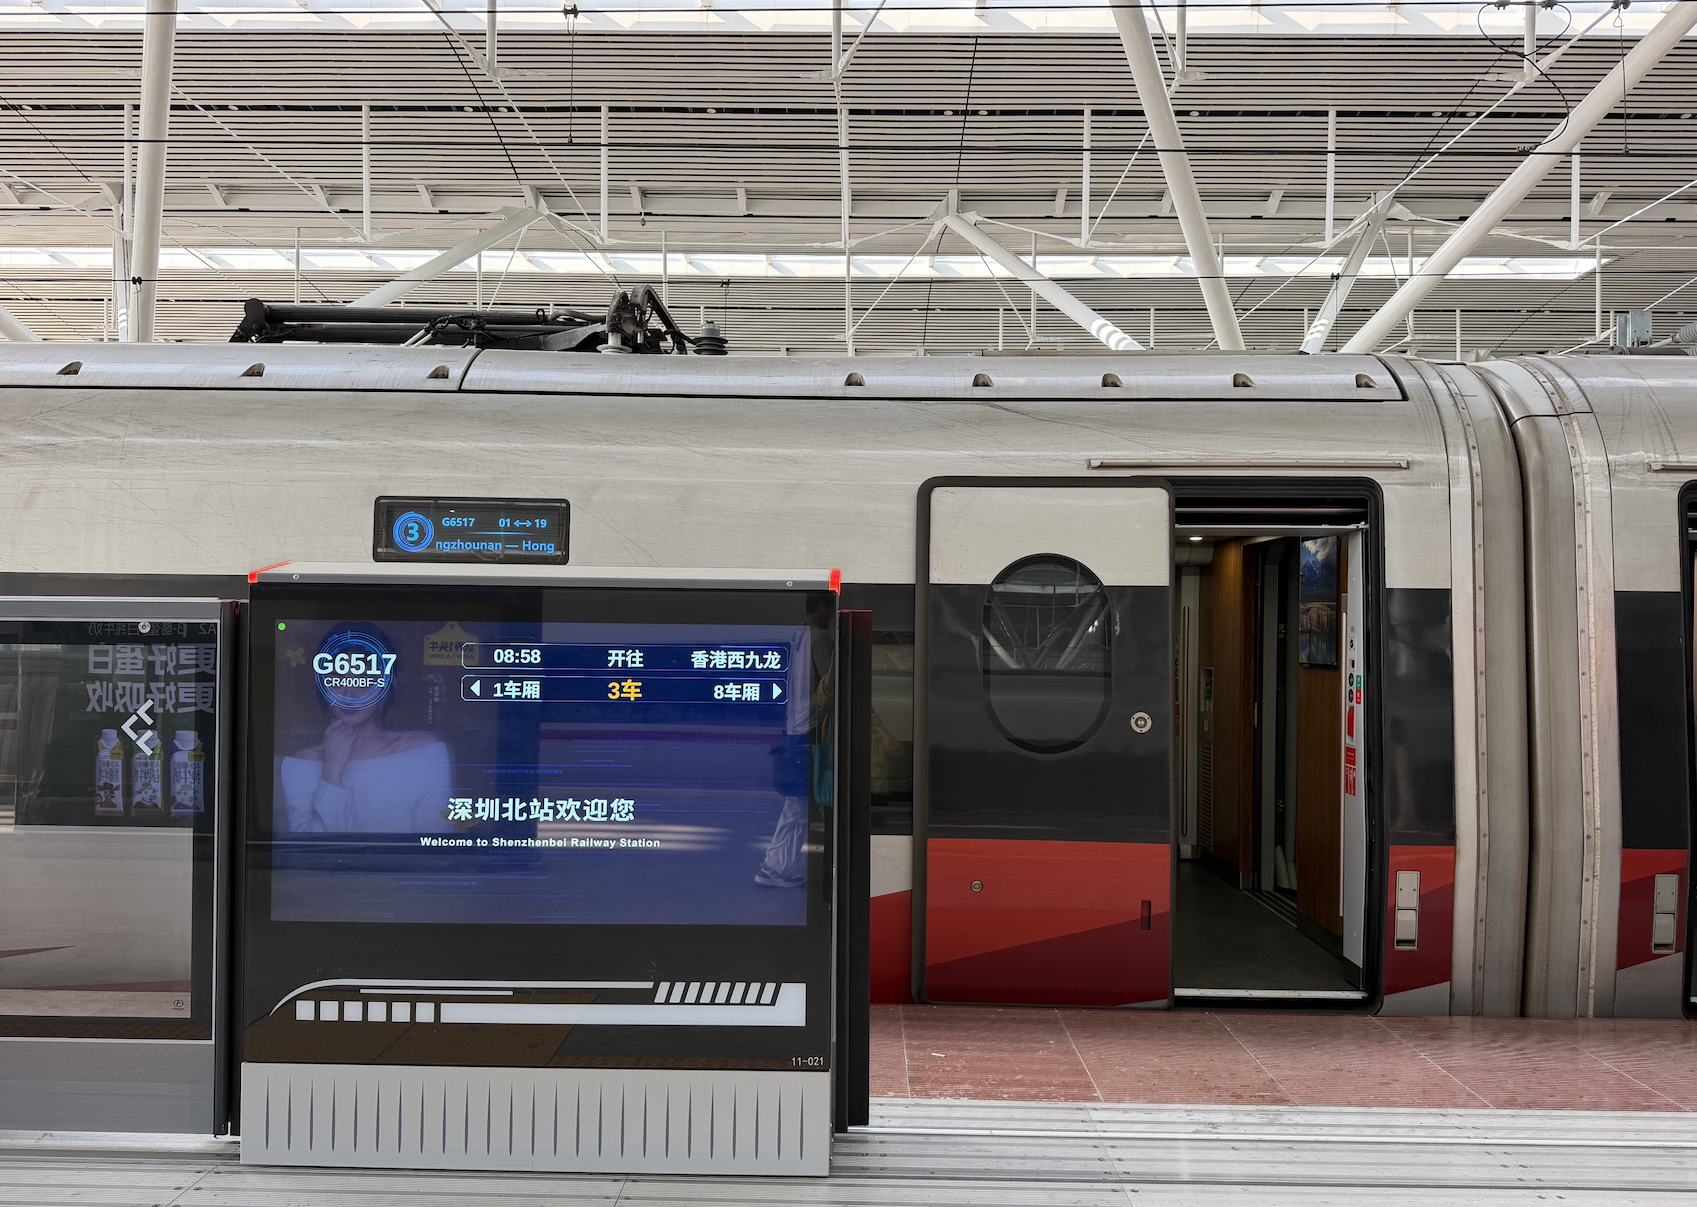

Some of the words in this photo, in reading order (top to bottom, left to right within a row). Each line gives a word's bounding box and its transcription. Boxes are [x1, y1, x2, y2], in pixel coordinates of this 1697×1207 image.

[441, 517, 476, 527] G6517
[498, 518, 511, 528] 01
[534, 518, 547, 528] 19
[406, 522, 420, 542] 3
[435, 538, 502, 552] ngzhounan
[522, 540, 555, 554] Hong
[312, 652, 397, 675] G6517
[493, 648, 542, 665] 08:58
[607, 649, 644, 668] 开往
[690, 650, 781, 669] 香港西九龙
[324, 677, 385, 688] CR400BF-S
[493, 681, 541, 701] 1车厢
[607, 678, 642, 701] 3车
[713, 682, 761, 701] 8车厢
[447, 797, 635, 821] 深圳北站欢迎您
[419, 837, 473, 847] Welcome
[476, 837, 489, 847] to
[492, 837, 567, 848] Shenzhenbei
[570, 837, 615, 850] Railway
[619, 838, 660, 848] Station
[791, 1056, 824, 1066] 11-021
